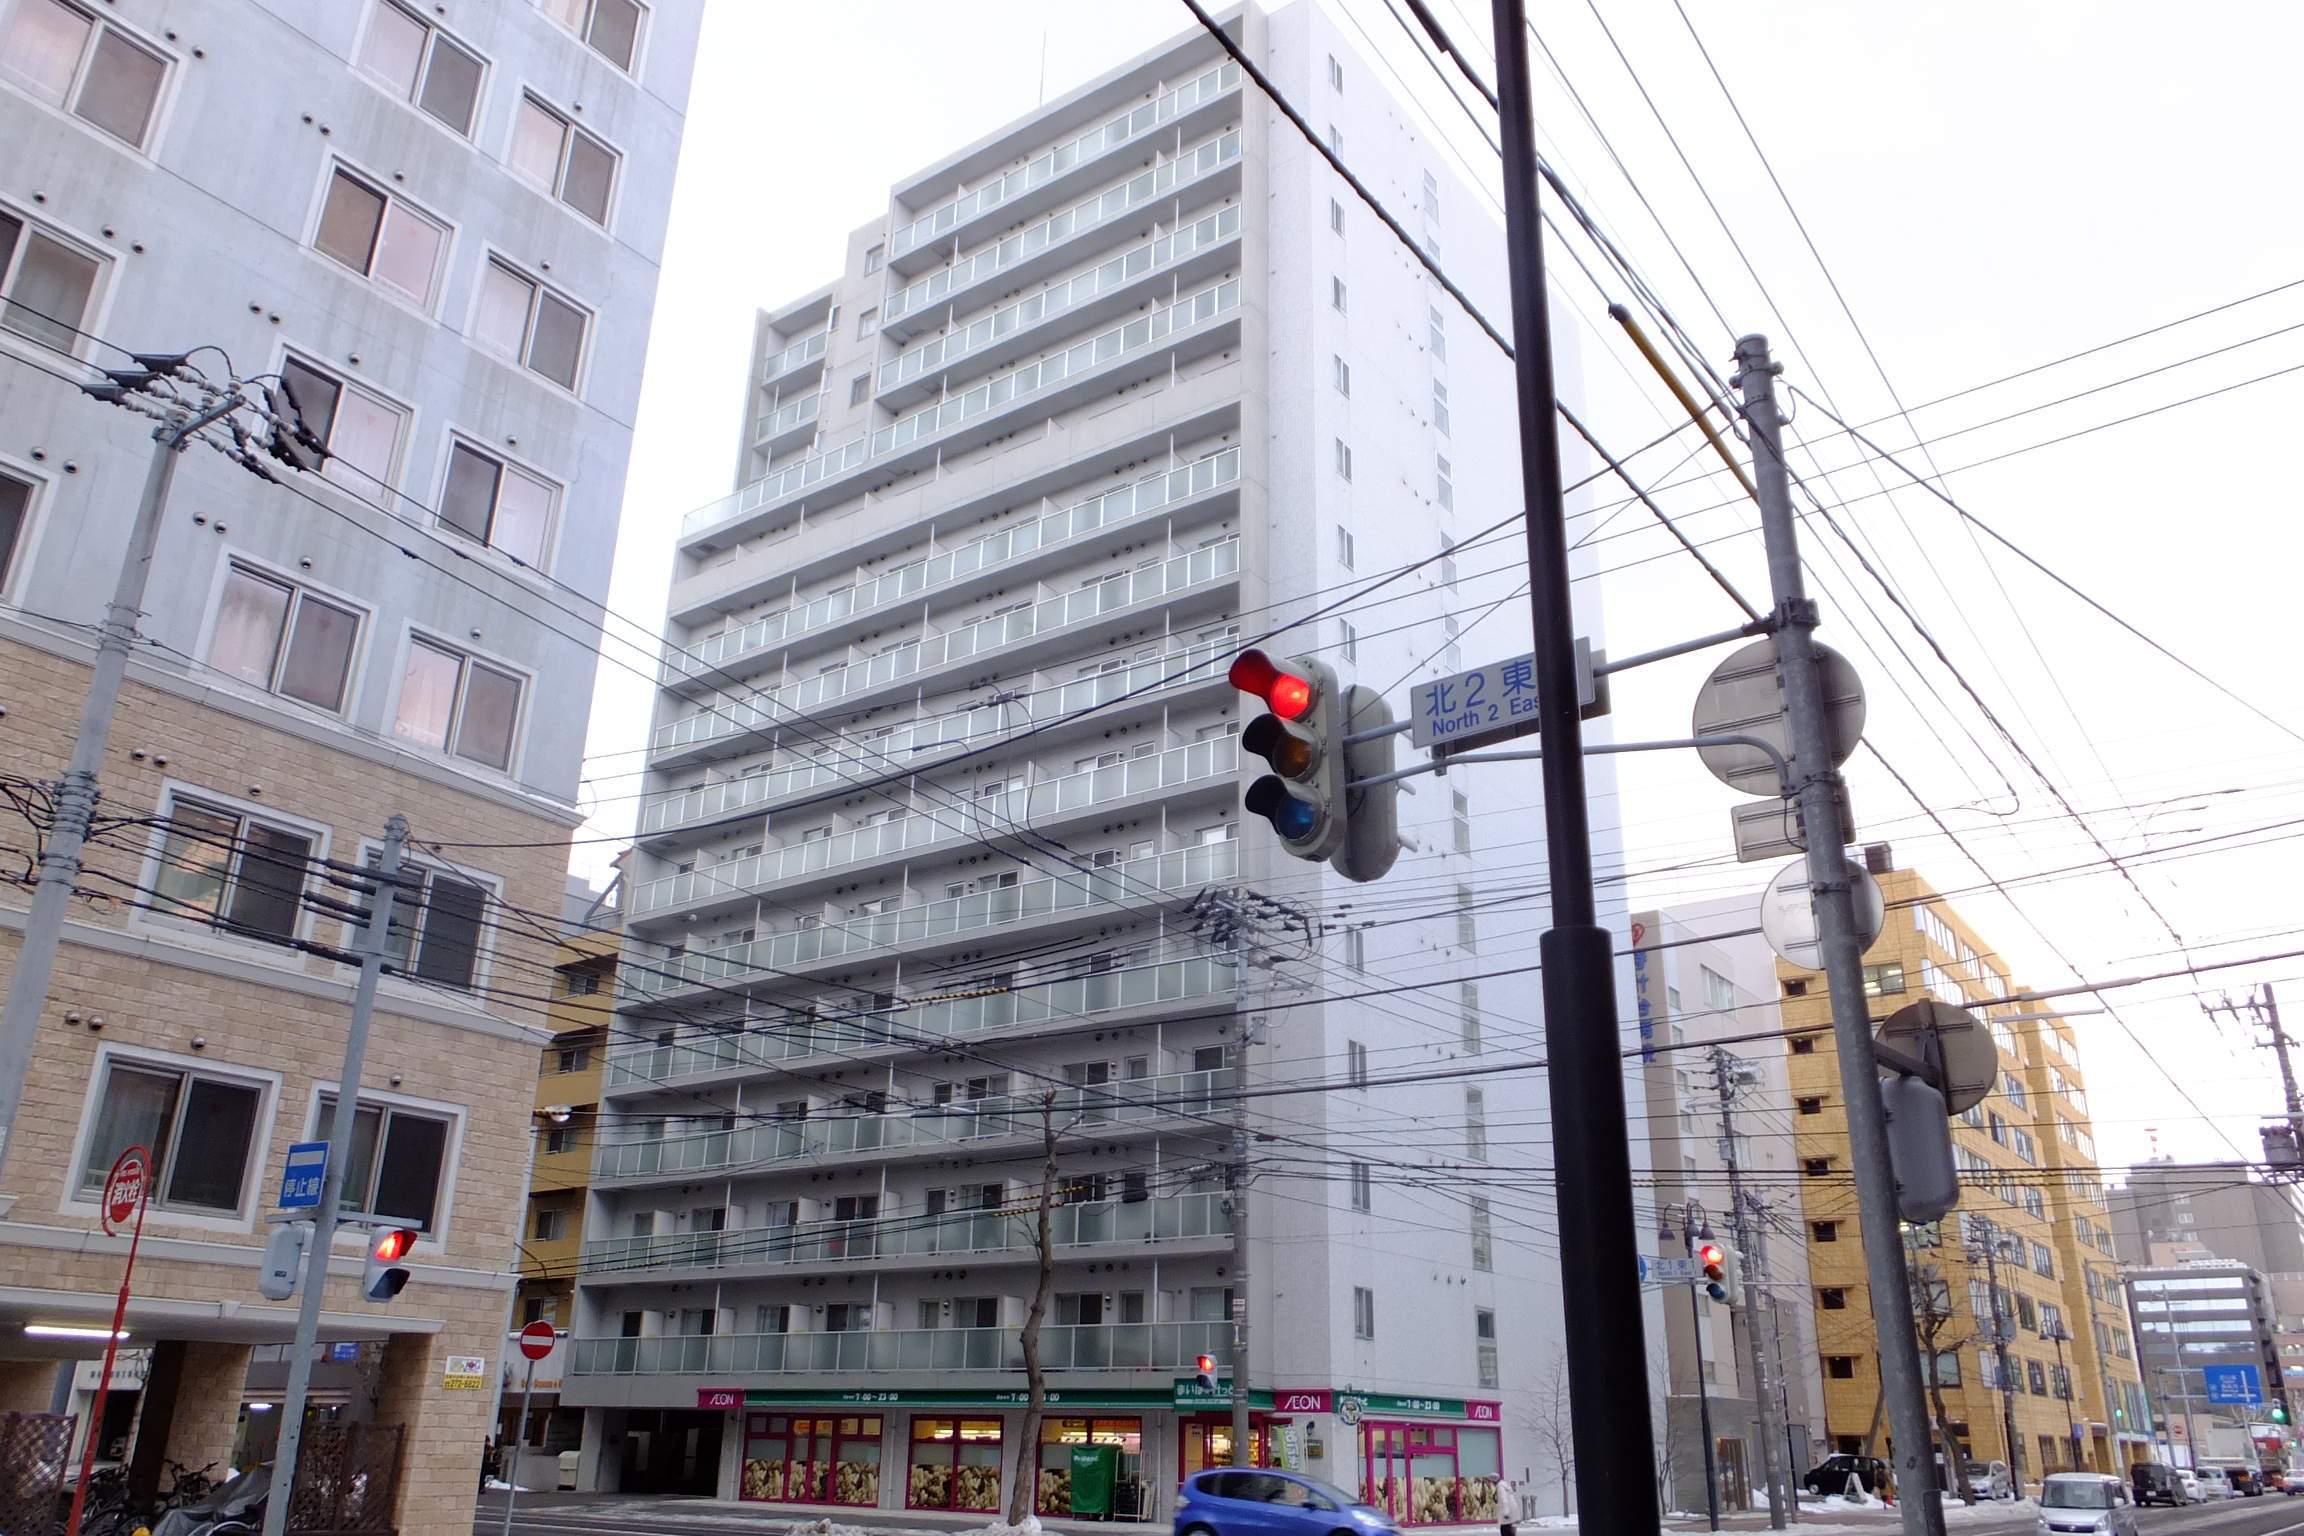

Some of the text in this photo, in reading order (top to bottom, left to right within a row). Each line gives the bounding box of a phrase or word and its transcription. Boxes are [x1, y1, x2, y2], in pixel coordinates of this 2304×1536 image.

[1432, 696, 1539, 737] North 2 Eas
[111, 1179, 141, 1205] 消火栓
[283, 1176, 321, 1198] 停止線
